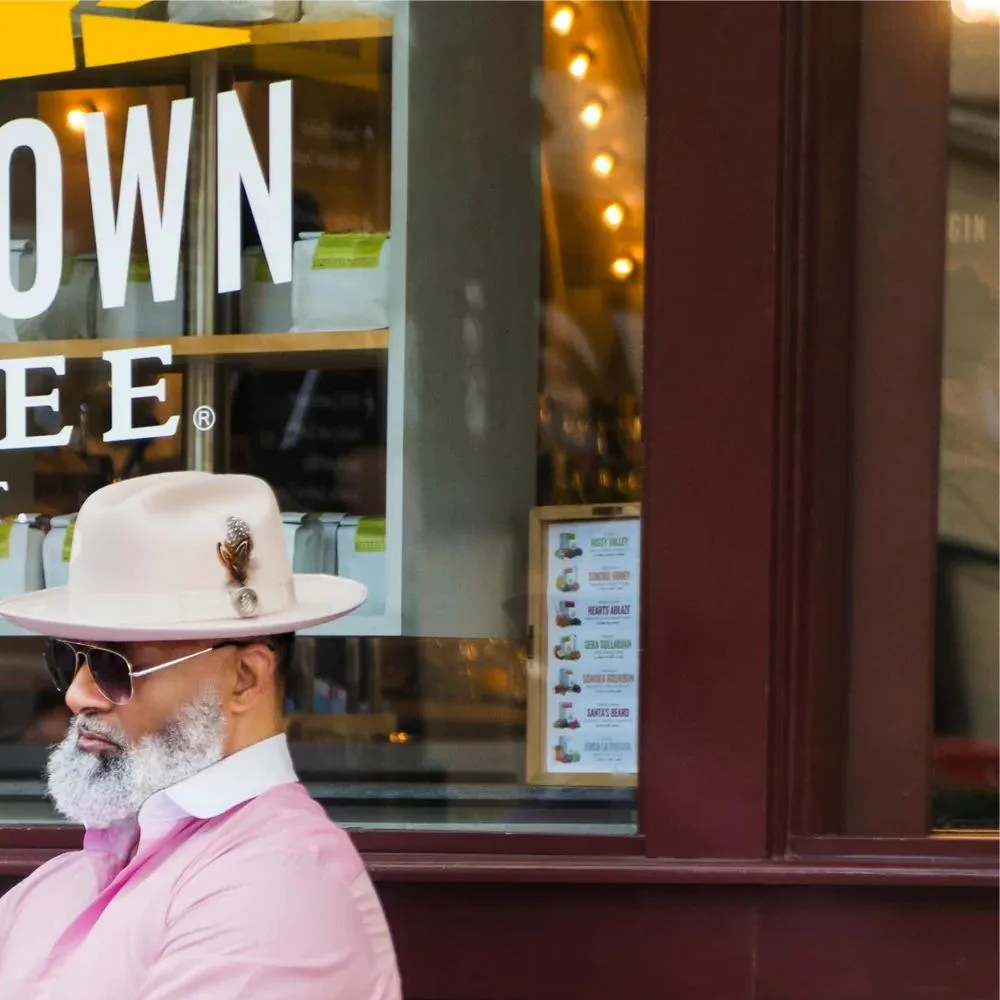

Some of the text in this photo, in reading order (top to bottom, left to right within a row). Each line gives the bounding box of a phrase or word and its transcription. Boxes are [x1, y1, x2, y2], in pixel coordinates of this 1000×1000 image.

[588, 605, 609, 616] HEARTS
[587, 708, 629, 718] SANTA'S BEARD
